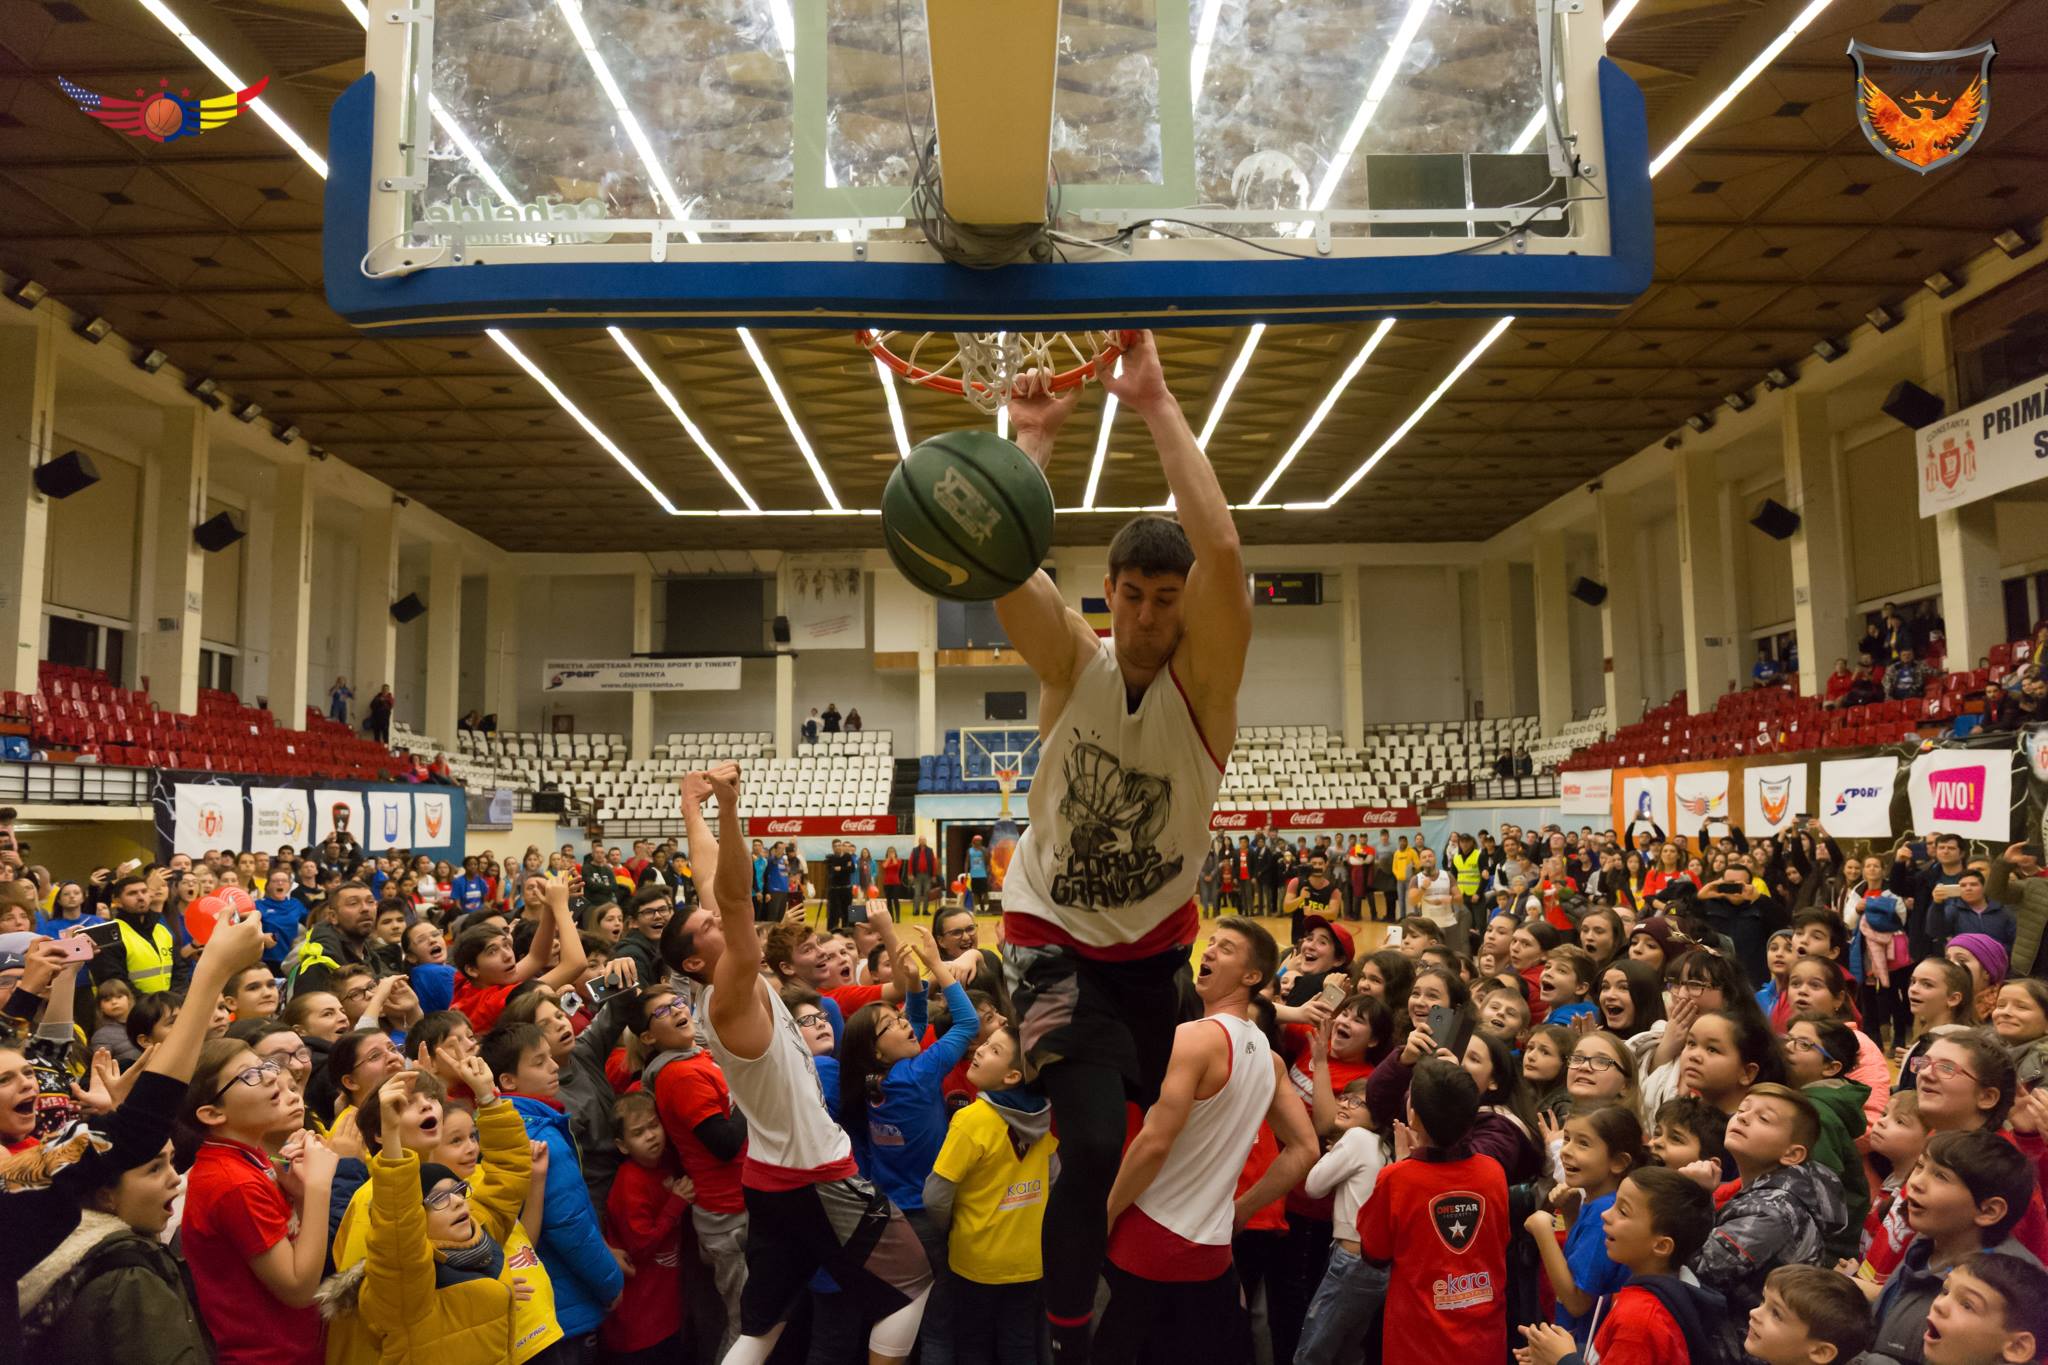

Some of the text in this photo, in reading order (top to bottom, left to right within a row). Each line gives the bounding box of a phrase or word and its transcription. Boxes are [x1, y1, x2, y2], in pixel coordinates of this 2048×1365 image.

[704, 660, 737, 668] TINERET
[1932, 781, 1975, 811] VIVO!
[1212, 814, 1248, 827] Coca-Cola
[1290, 812, 1325, 825] Coca-Cola
[1363, 811, 1398, 824] Coca-Cola
[767, 820, 803, 833] Coca-Cola
[841, 818, 877, 832] Coca-Cola
[1433, 1271, 1490, 1297] ekara
